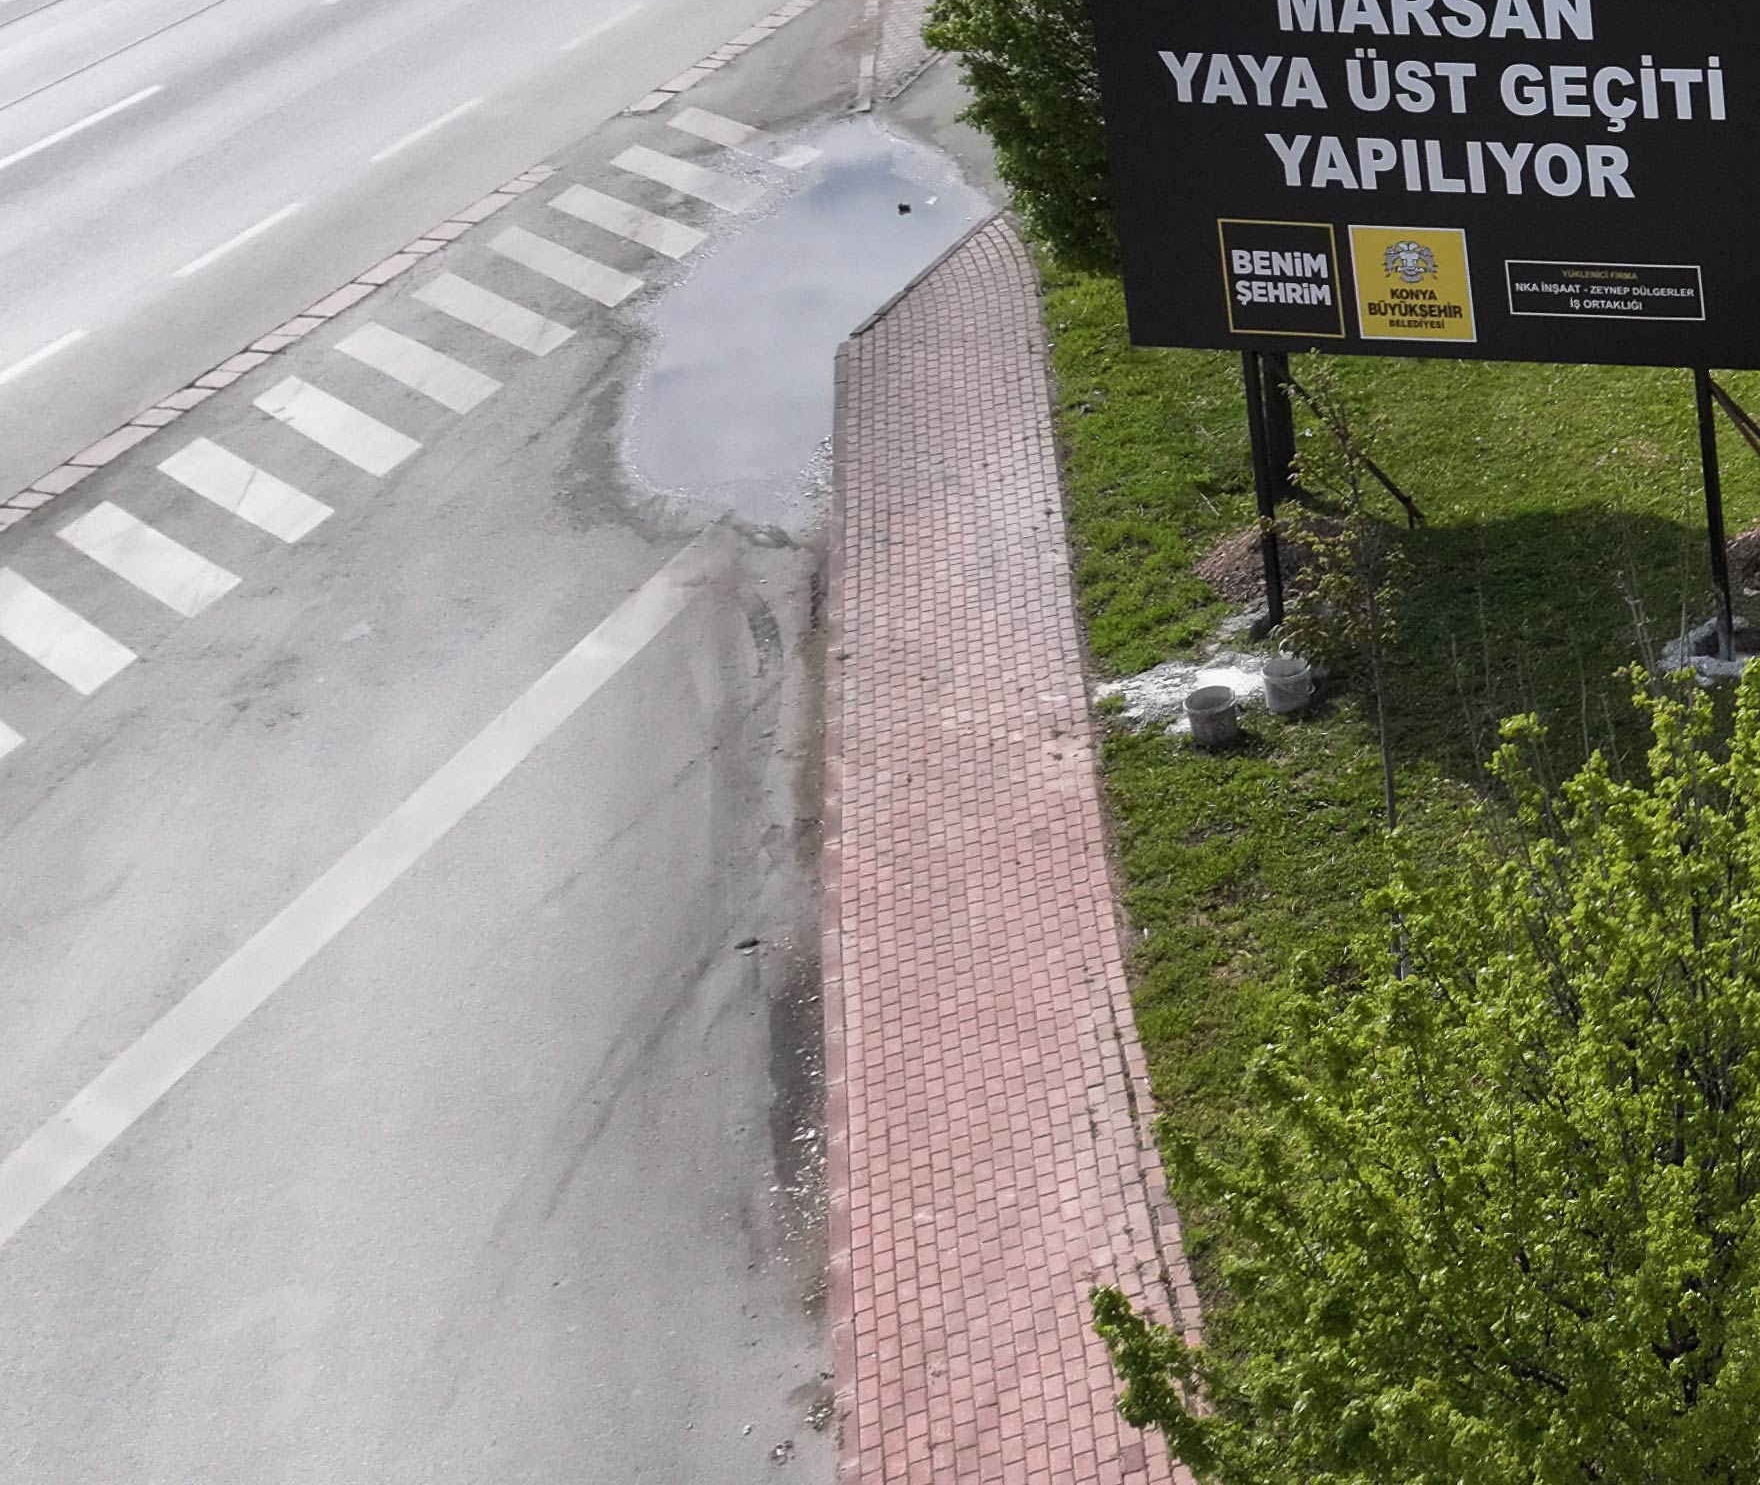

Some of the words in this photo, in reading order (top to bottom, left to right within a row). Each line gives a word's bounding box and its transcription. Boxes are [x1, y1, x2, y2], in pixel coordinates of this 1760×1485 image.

[1158, 50, 1328, 109] YAYA
[1345, 47, 1477, 114] ÜST
[1499, 54, 1726, 133] GEÇİTİ
[1264, 133, 1636, 199] YAPILIYOR
[1390, 288, 1438, 301] KONYA
[1514, 282, 1540, 293] NKA
[1541, 281, 1581, 295] İNŞAAT
[1589, 285, 1631, 296] ZEYNEP
[1632, 285, 1695, 298] DÜLGERLER
[1367, 301, 1463, 319] BÜYÜKŞEHİR
[1569, 298, 1581, 310] İŞ
[1582, 298, 1643, 311] ORTAKLIĞI
[1388, 318, 1445, 329] BELEDİYESİ
